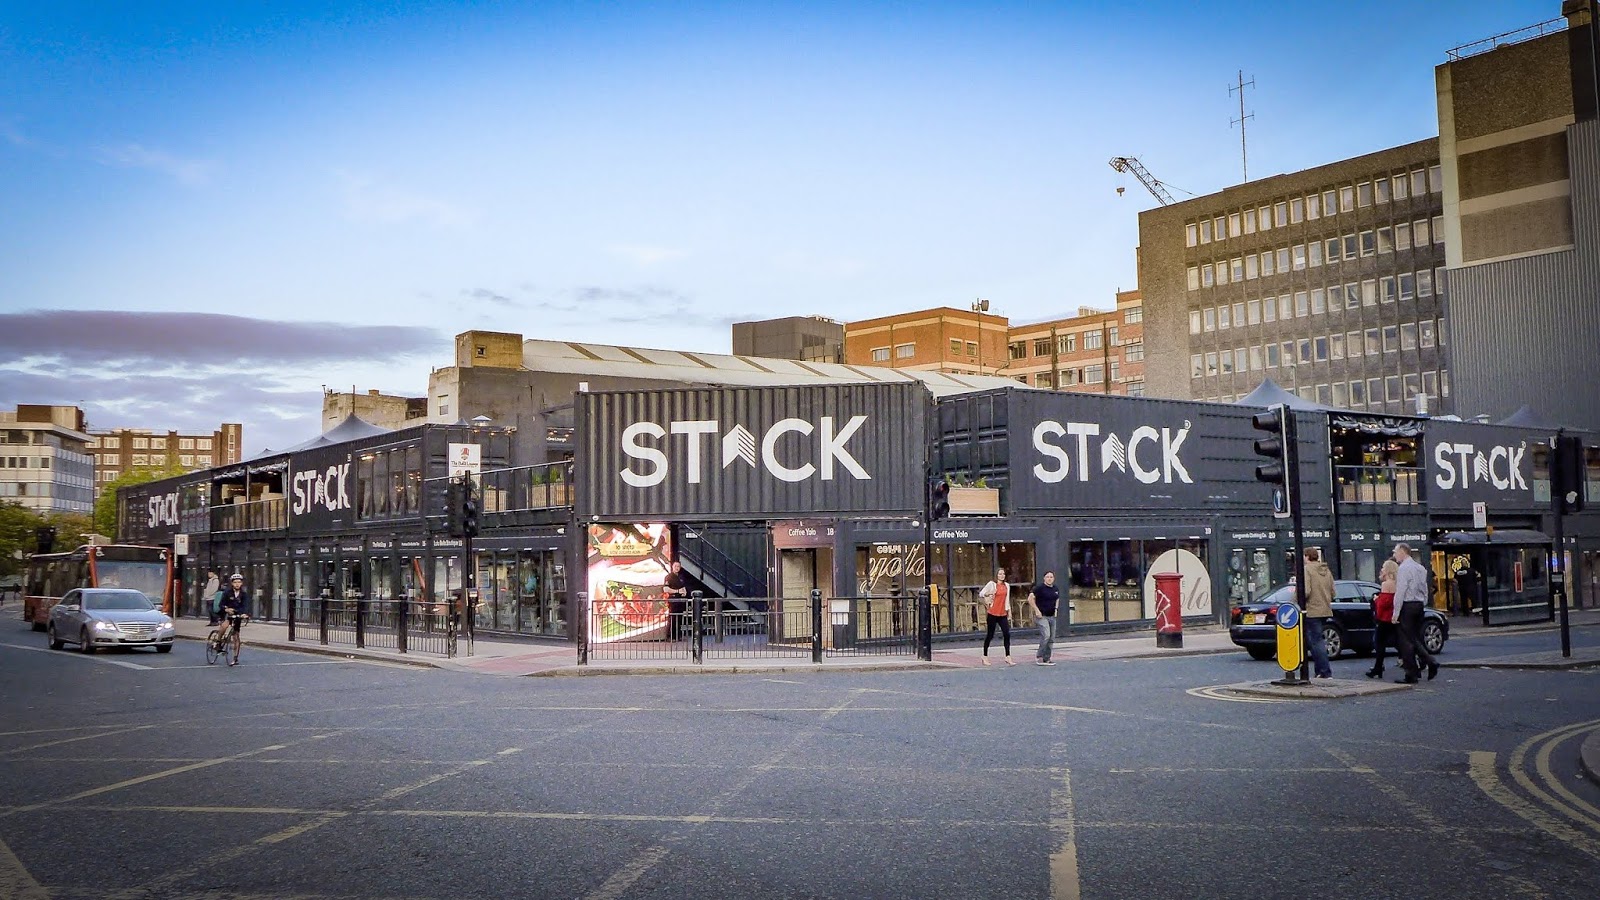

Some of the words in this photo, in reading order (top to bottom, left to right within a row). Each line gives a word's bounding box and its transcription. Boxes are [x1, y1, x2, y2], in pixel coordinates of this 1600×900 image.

[788, 528, 805, 536] Coffee
[805, 528, 817, 536] Yolo
[827, 528, 834, 536] 18
[934, 531, 955, 539] Coffee
[955, 530, 968, 539] Yolo
